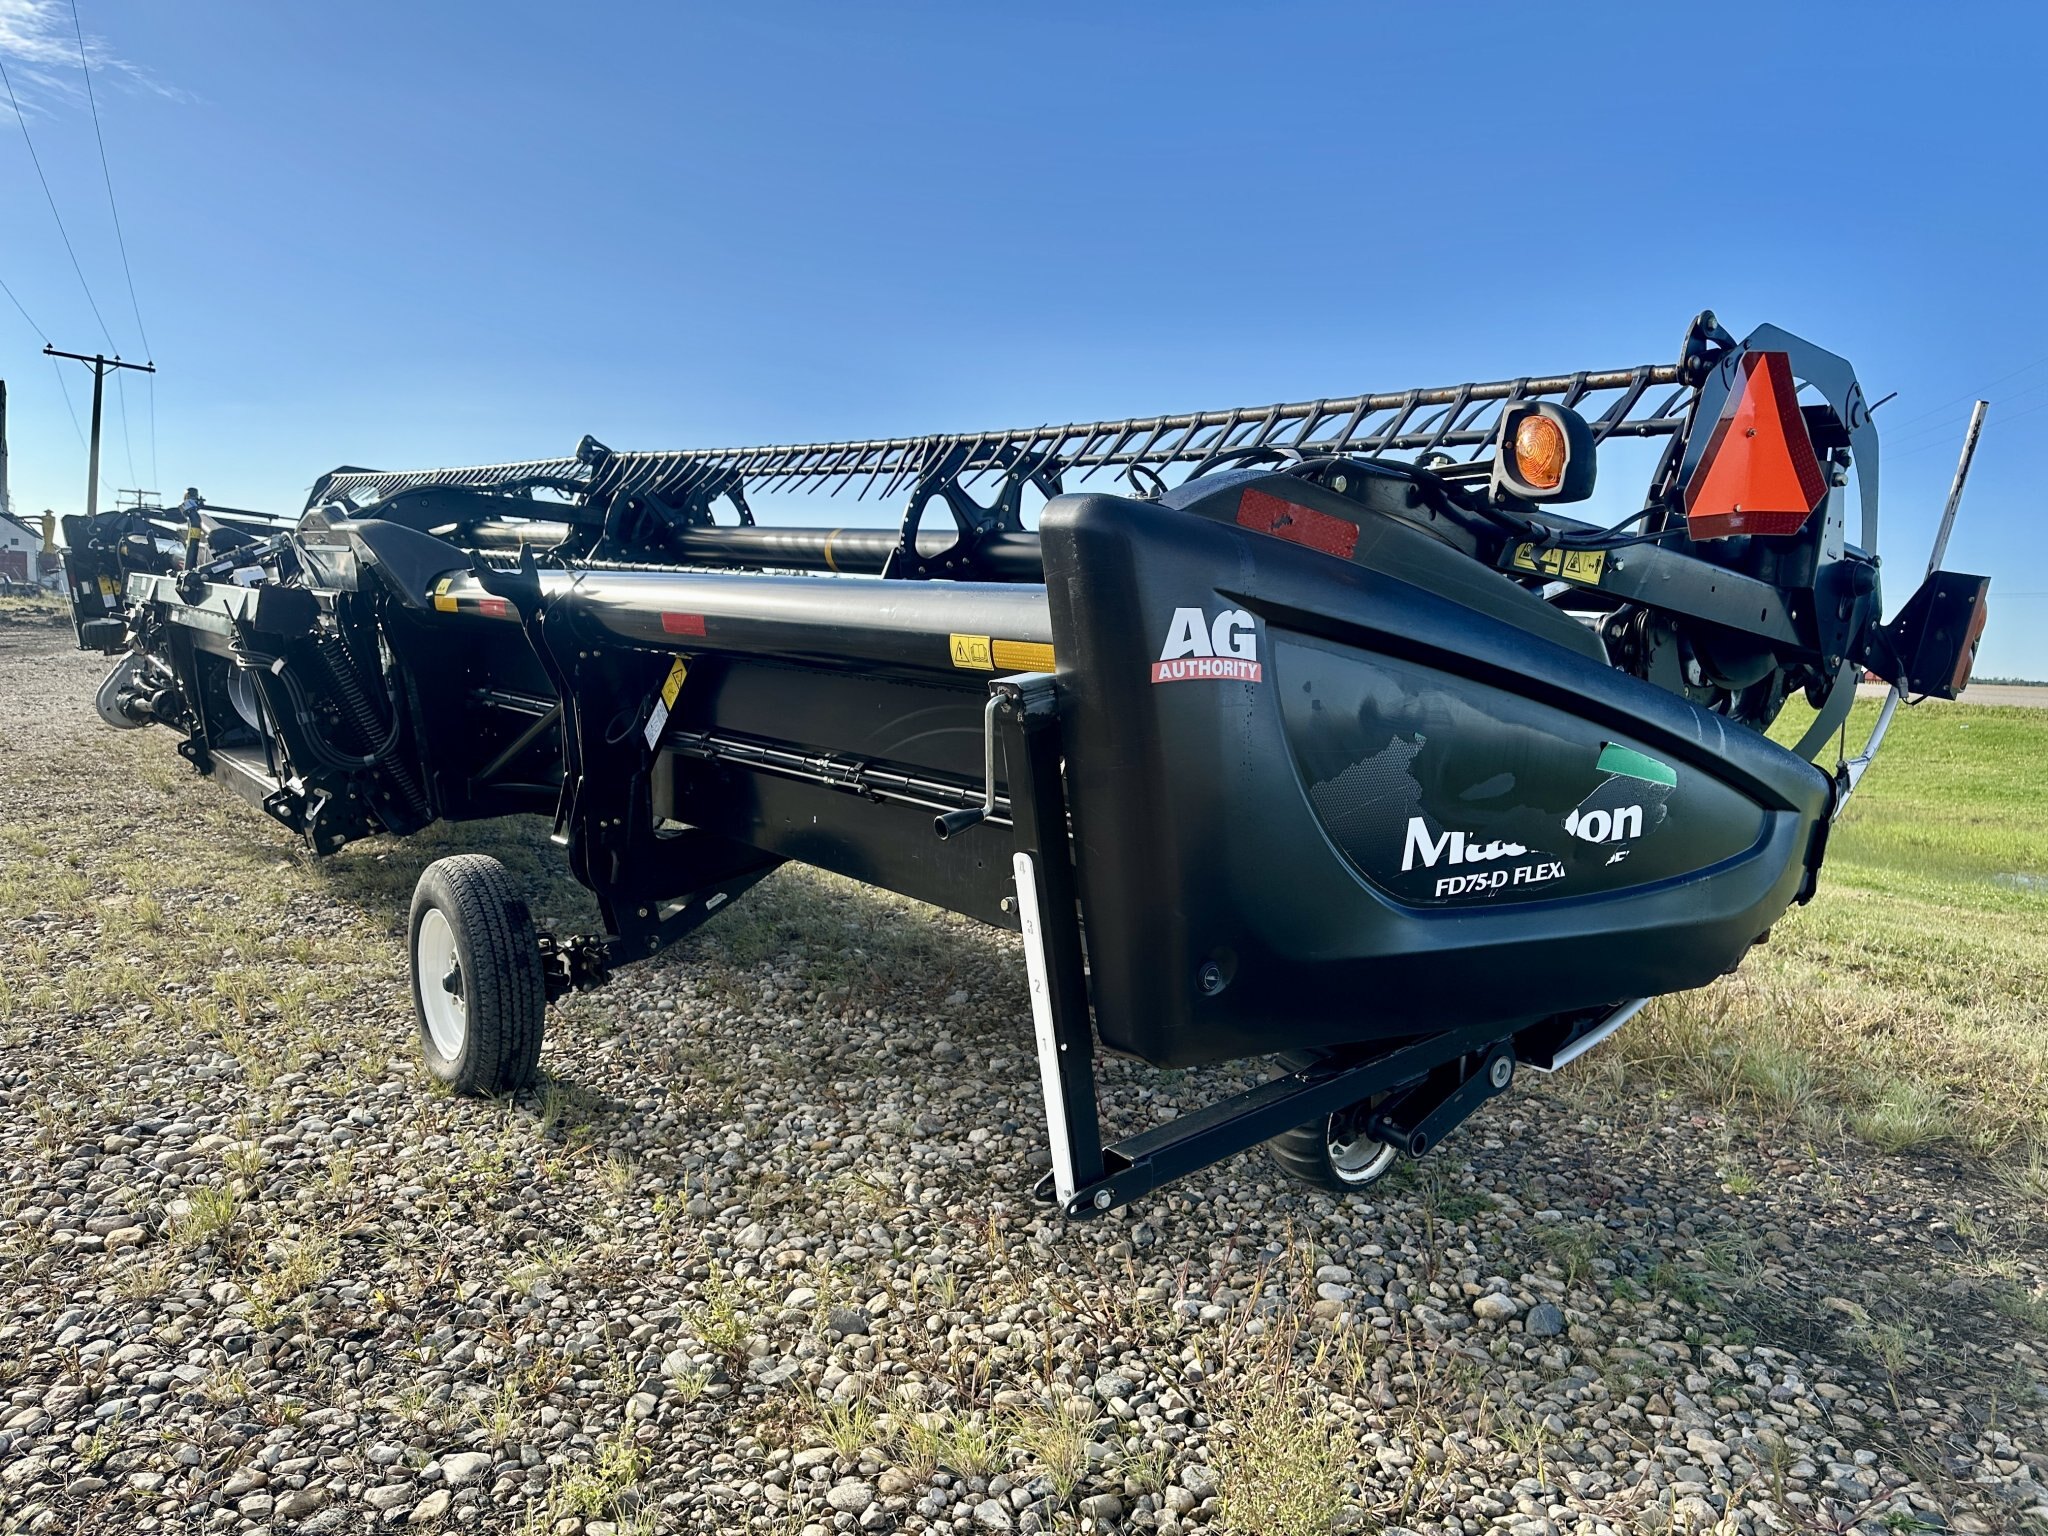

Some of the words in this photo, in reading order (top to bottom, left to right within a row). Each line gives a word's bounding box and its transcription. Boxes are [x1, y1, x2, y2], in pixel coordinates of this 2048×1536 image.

[1159, 607, 1257, 661] AG
[1158, 659, 1258, 680] AUTHORITY
[1435, 870, 1509, 897] FD75-D
[1026, 919, 1034, 935] 3
[1034, 978, 1041, 993] 2
